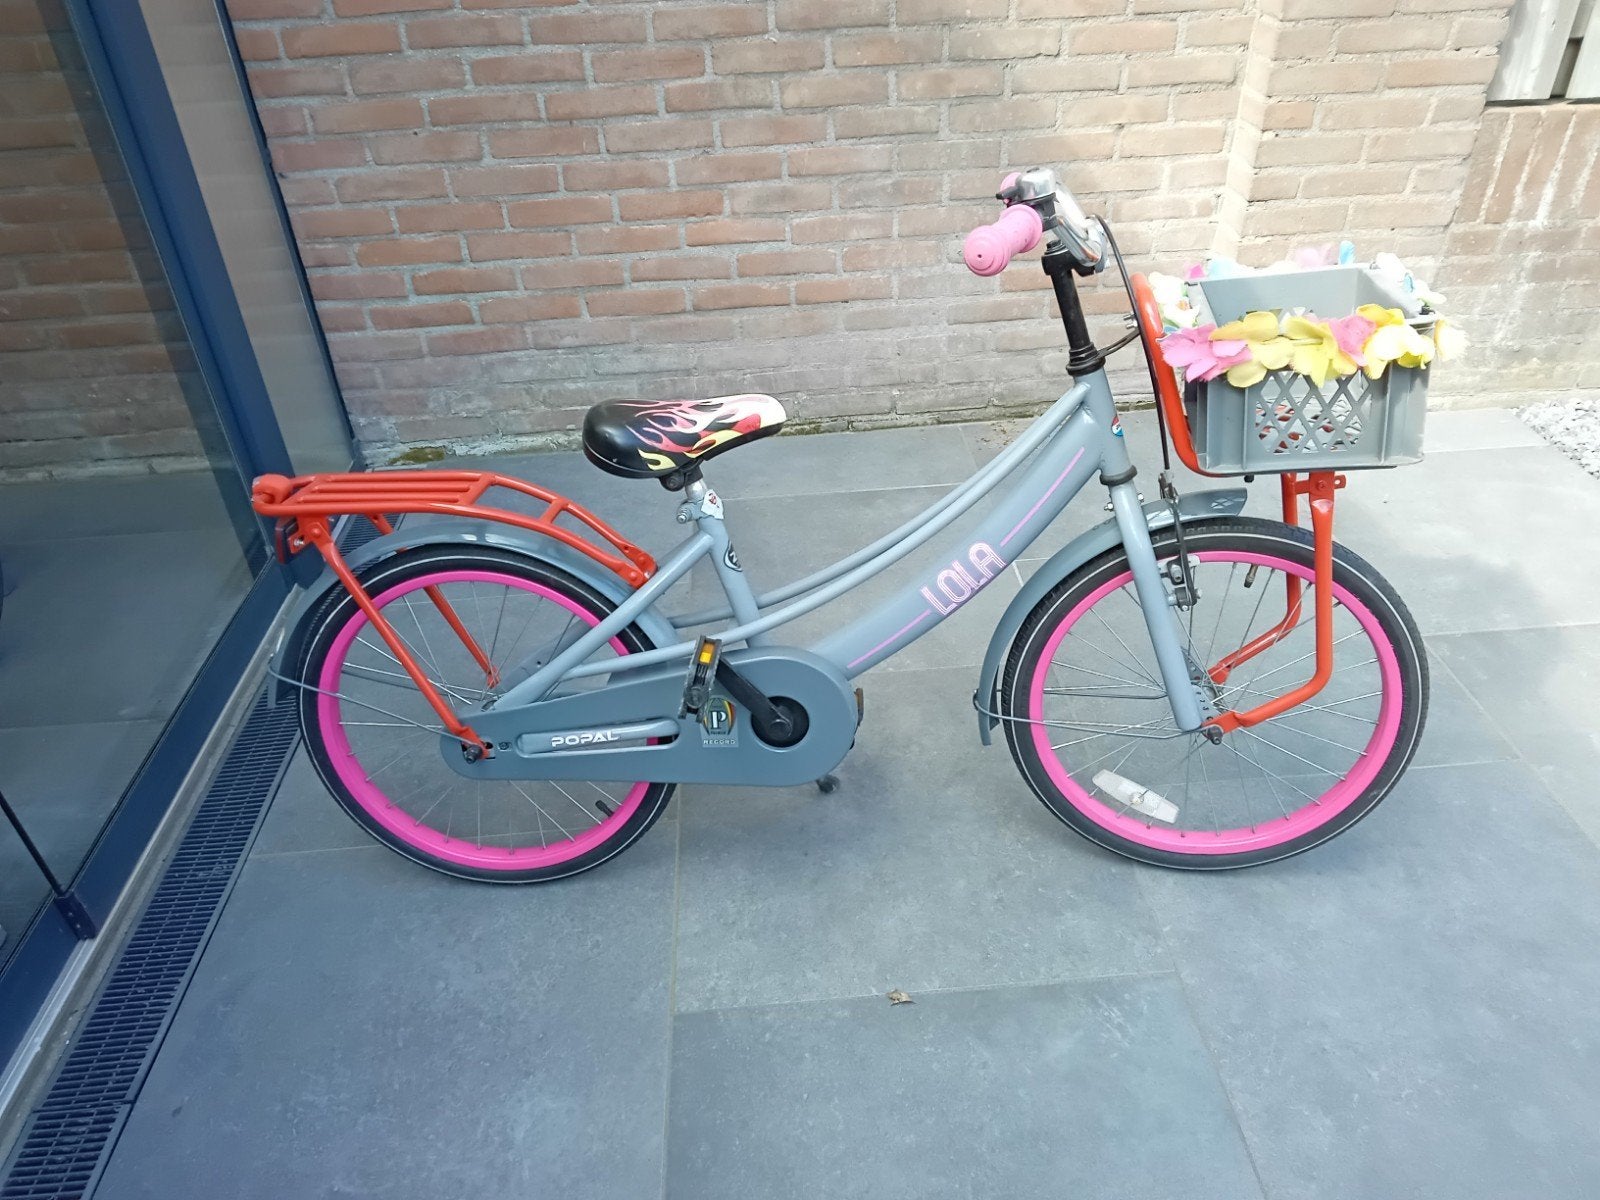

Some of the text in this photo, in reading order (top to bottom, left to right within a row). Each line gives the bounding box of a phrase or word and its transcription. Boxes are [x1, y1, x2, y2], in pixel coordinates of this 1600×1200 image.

[921, 542, 1007, 615] LOLA
[711, 710, 728, 729] P
[551, 730, 619, 747] POPAL
